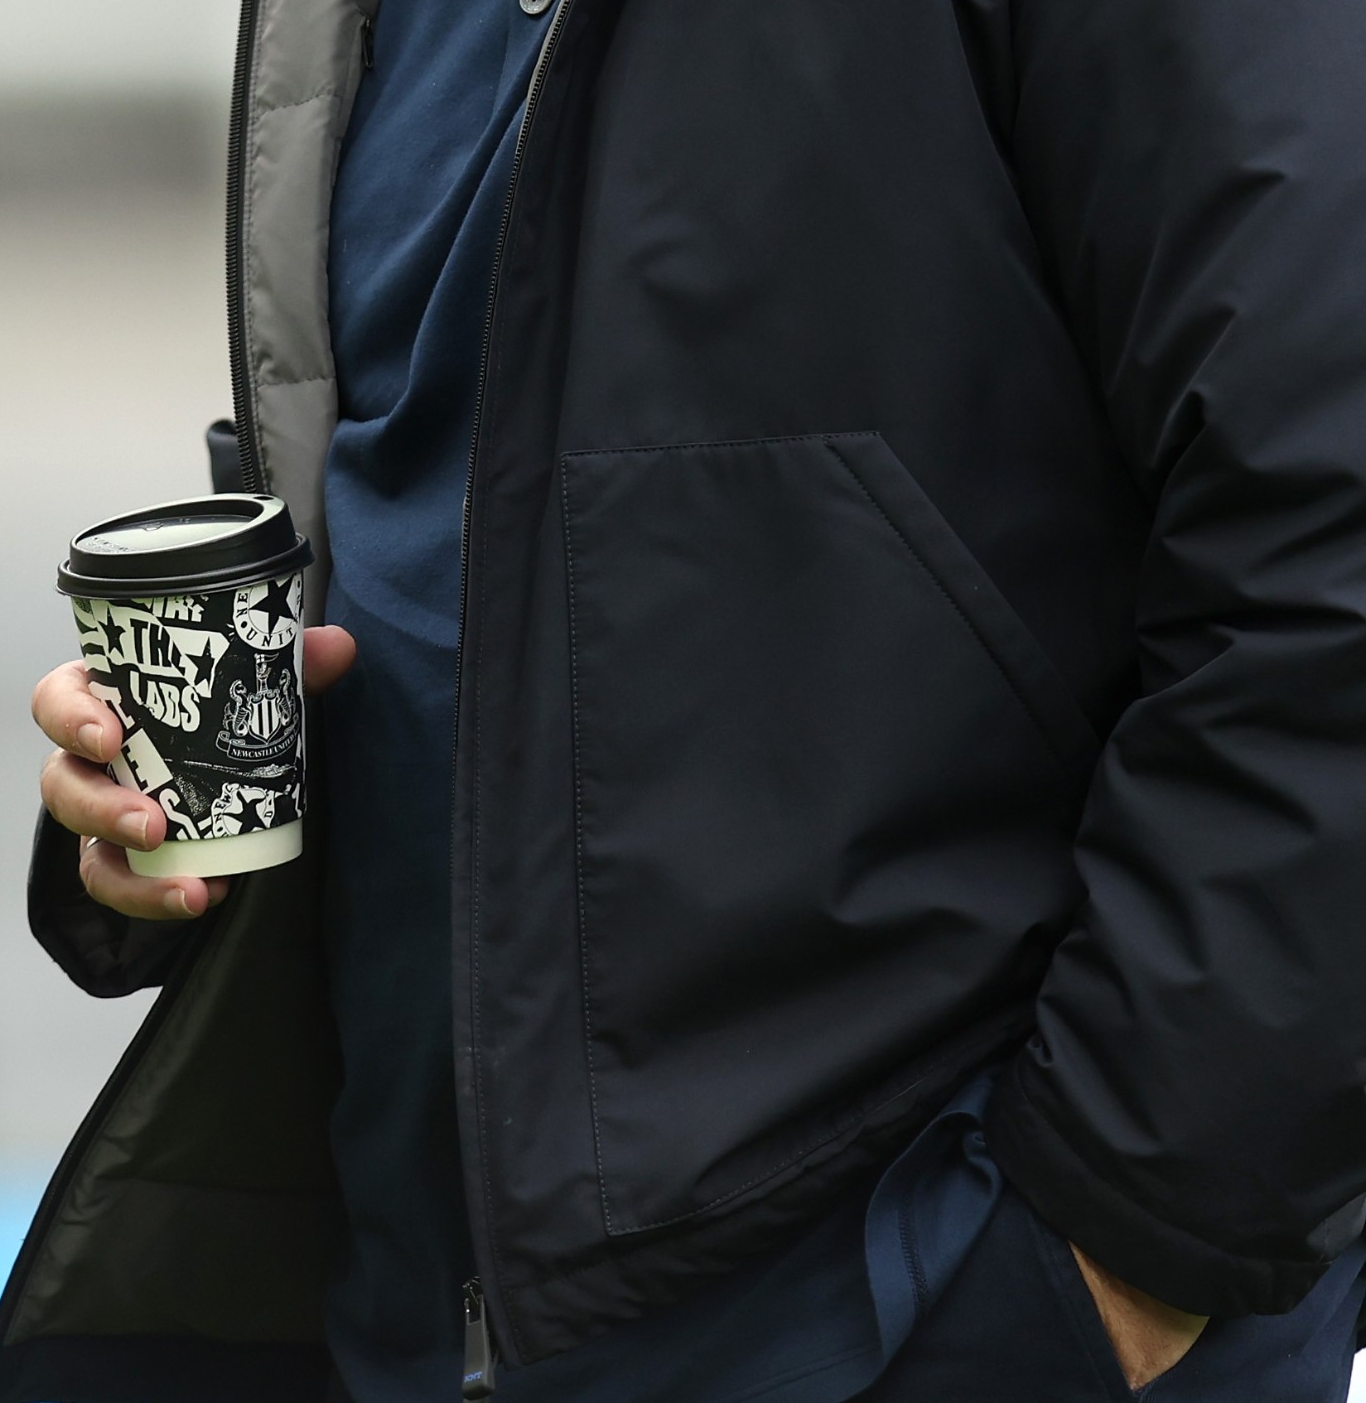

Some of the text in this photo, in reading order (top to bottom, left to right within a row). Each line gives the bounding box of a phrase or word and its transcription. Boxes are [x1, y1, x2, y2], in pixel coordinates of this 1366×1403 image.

[130, 670, 201, 732] LADS
[230, 734, 295, 758] NEWCASTLE UNITED
